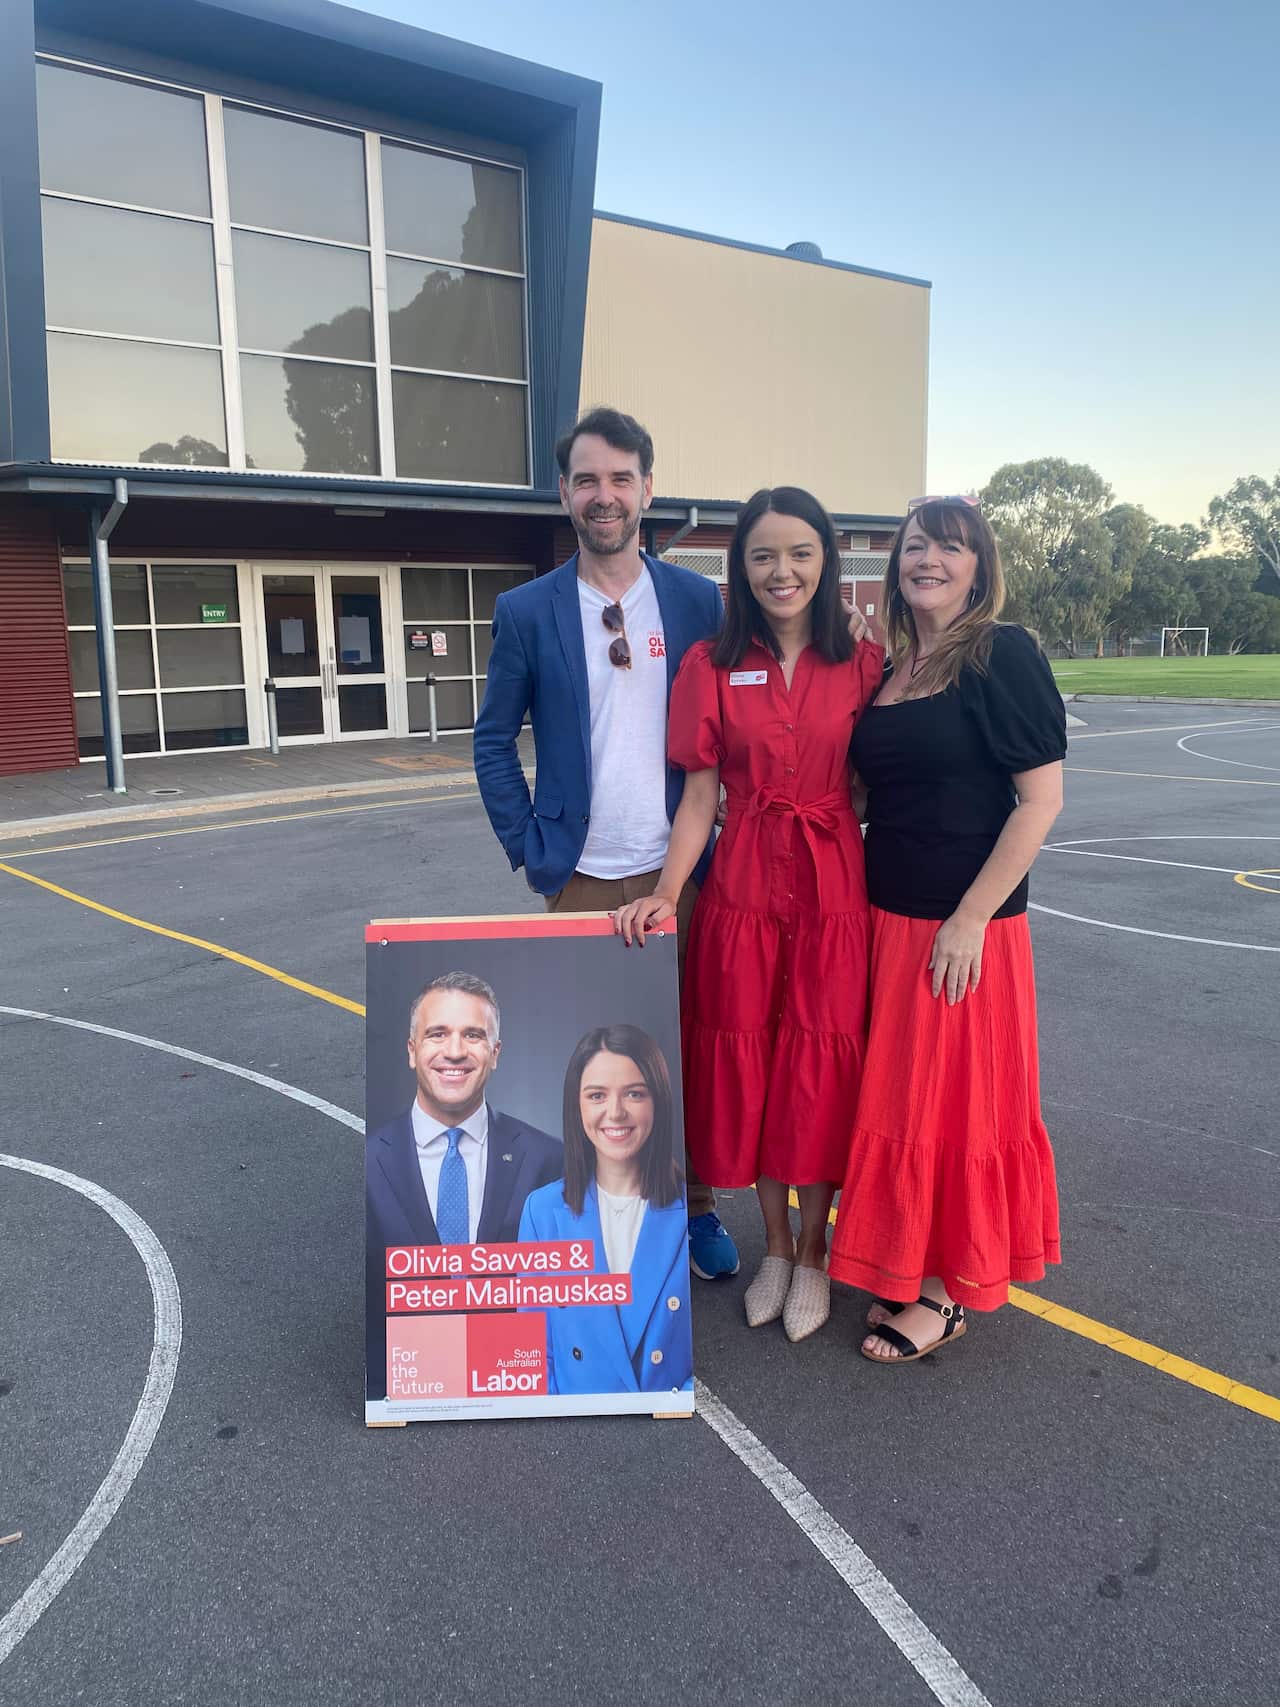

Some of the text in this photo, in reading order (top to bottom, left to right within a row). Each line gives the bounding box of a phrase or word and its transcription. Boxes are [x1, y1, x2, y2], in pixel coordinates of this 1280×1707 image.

[203, 609, 225, 617] ENTRY
[388, 1243, 589, 1275] Olivia Savvas &
[389, 1276, 627, 1309] Peter Malinauskas
[392, 1347, 418, 1362] For
[513, 1348, 542, 1359] South
[496, 1357, 542, 1368] Australian
[391, 1363, 418, 1379] the
[391, 1379, 445, 1395] Future
[472, 1369, 542, 1392] Labor
